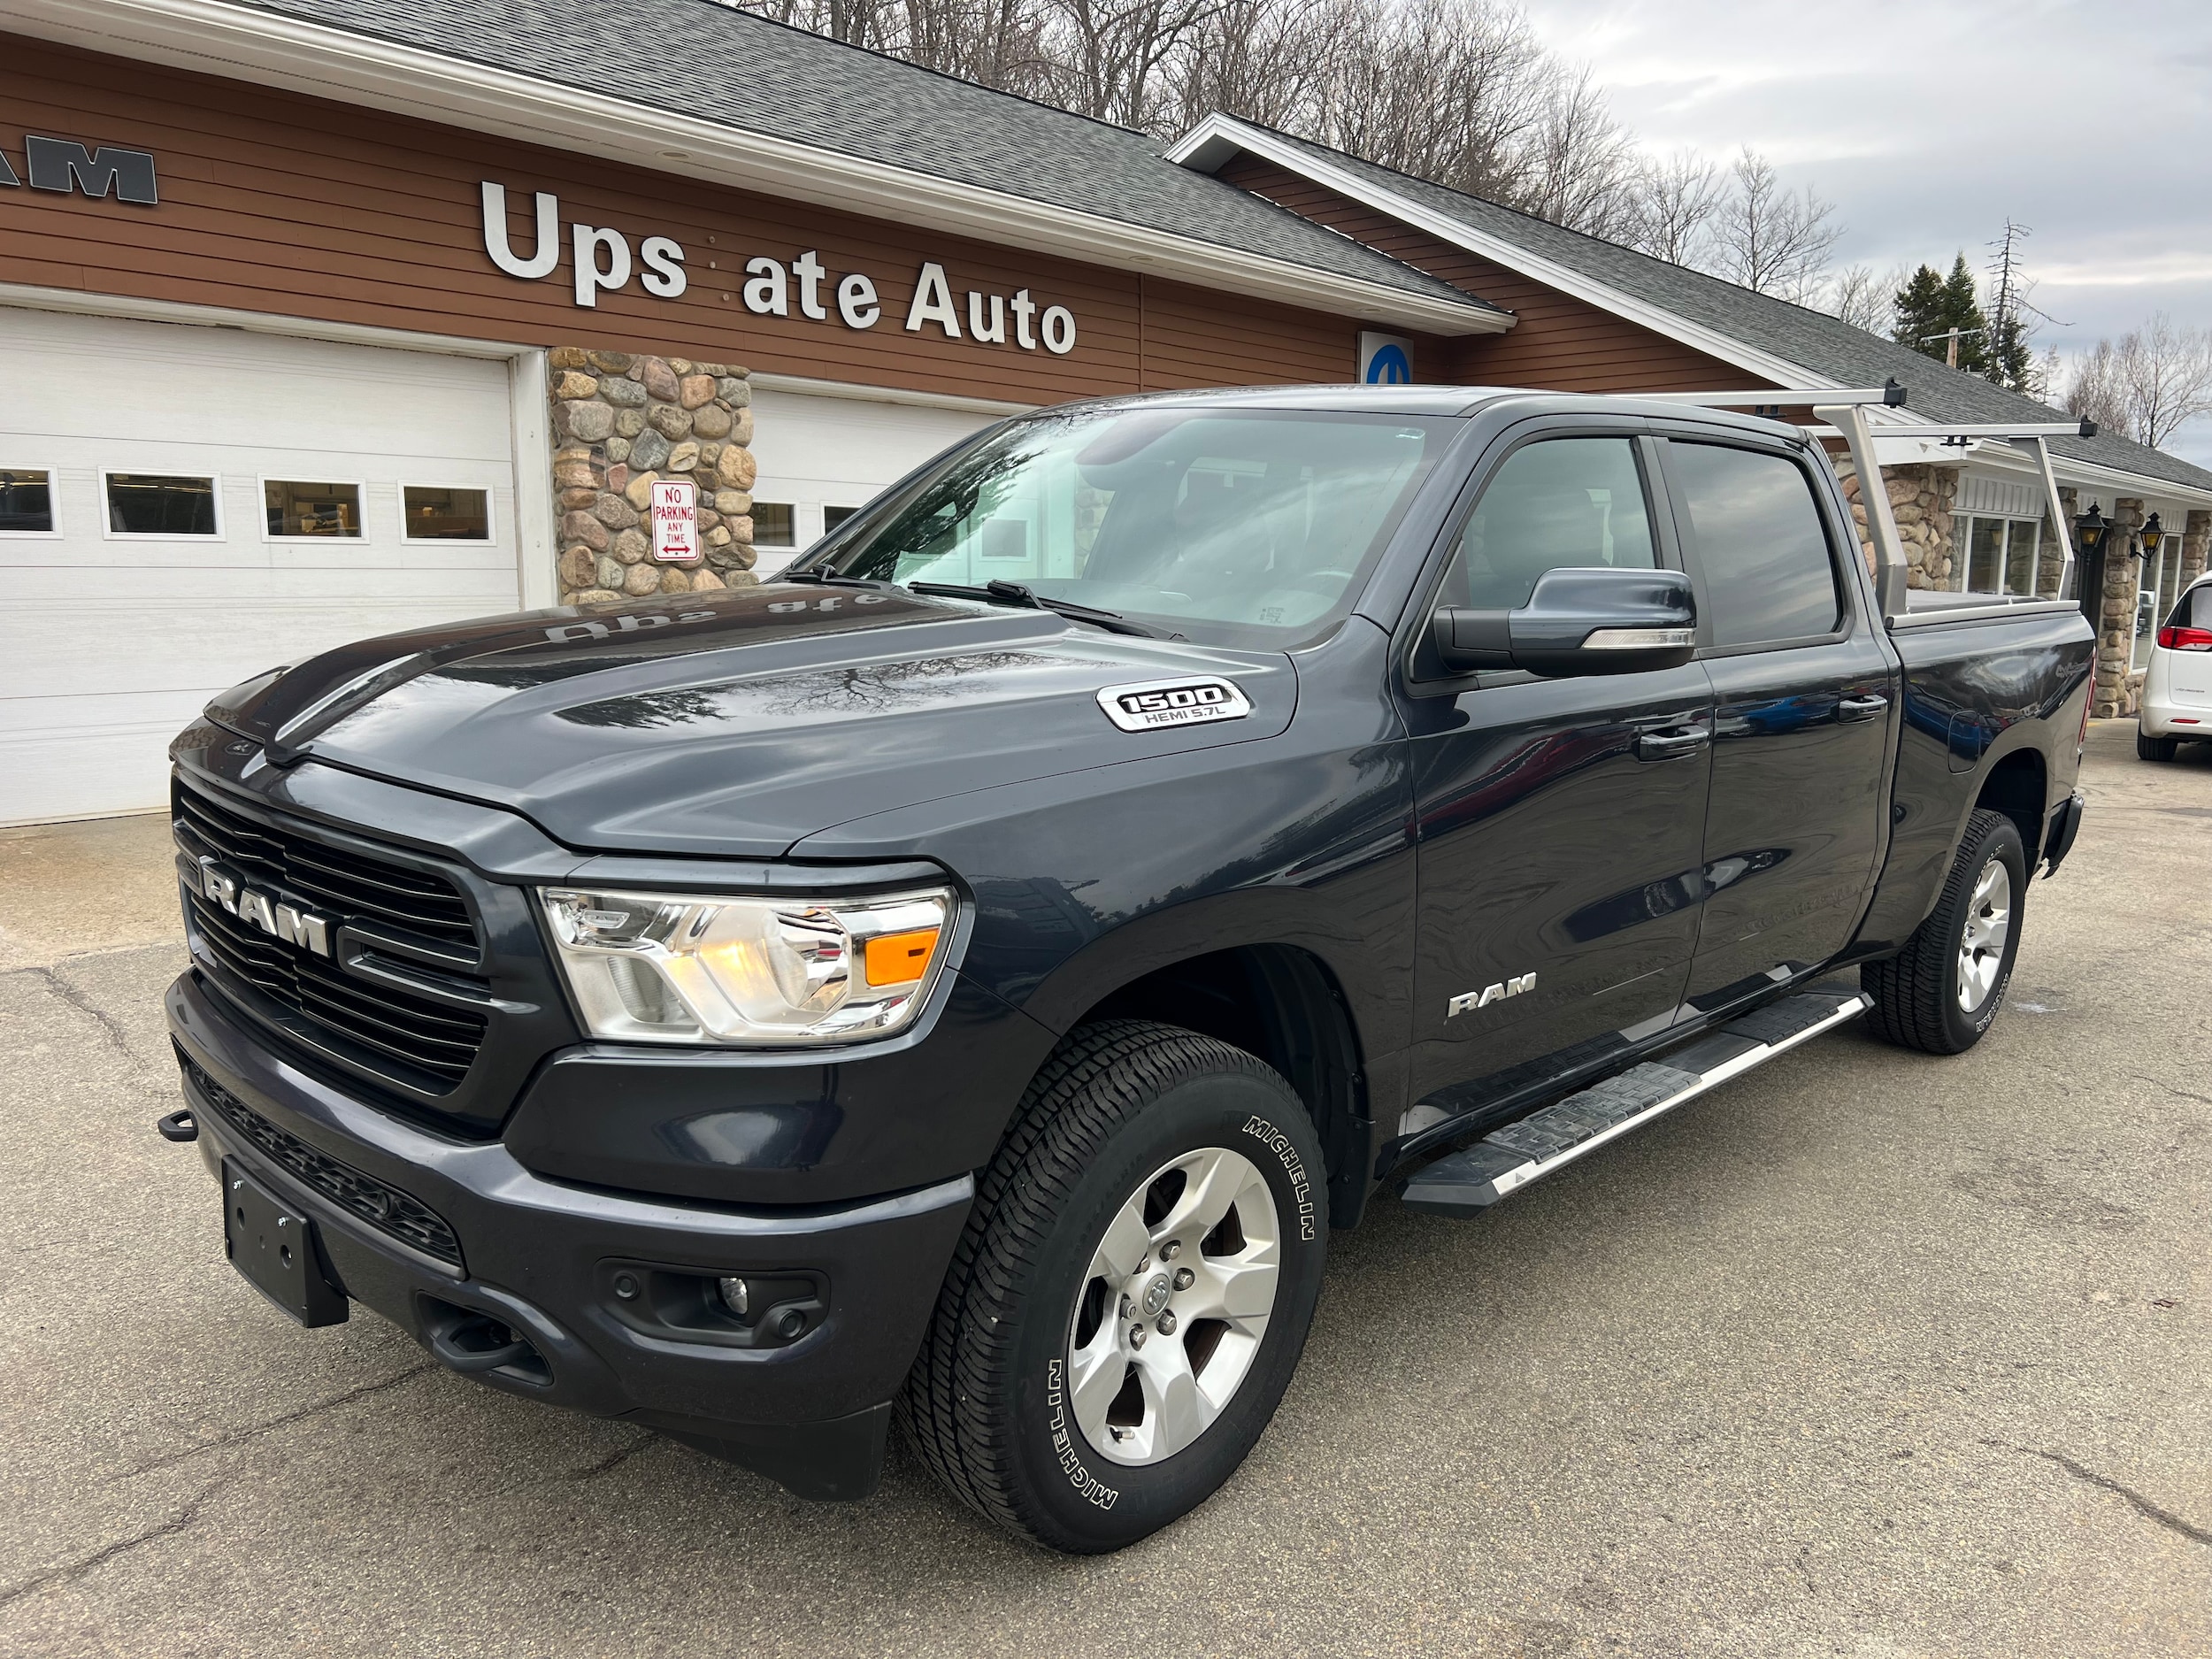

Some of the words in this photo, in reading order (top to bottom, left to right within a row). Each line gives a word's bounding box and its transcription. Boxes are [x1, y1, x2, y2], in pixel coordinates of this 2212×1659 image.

[905, 261, 1077, 355] Auto
[665, 489, 681, 503] NO
[656, 506, 694, 521] PARKING
[666, 534, 686, 543] TIME
[667, 522, 683, 532] ANY
[1121, 687, 1225, 713] 1500
[1145, 710, 1188, 724] HEMI
[1191, 706, 1226, 718] 5.7L
[202, 863, 331, 958] RAM
[1448, 972, 1537, 1018] RAM
[1242, 1115, 1315, 1240] MICHELIN
[1048, 1359, 1119, 1510] MICHELIN
